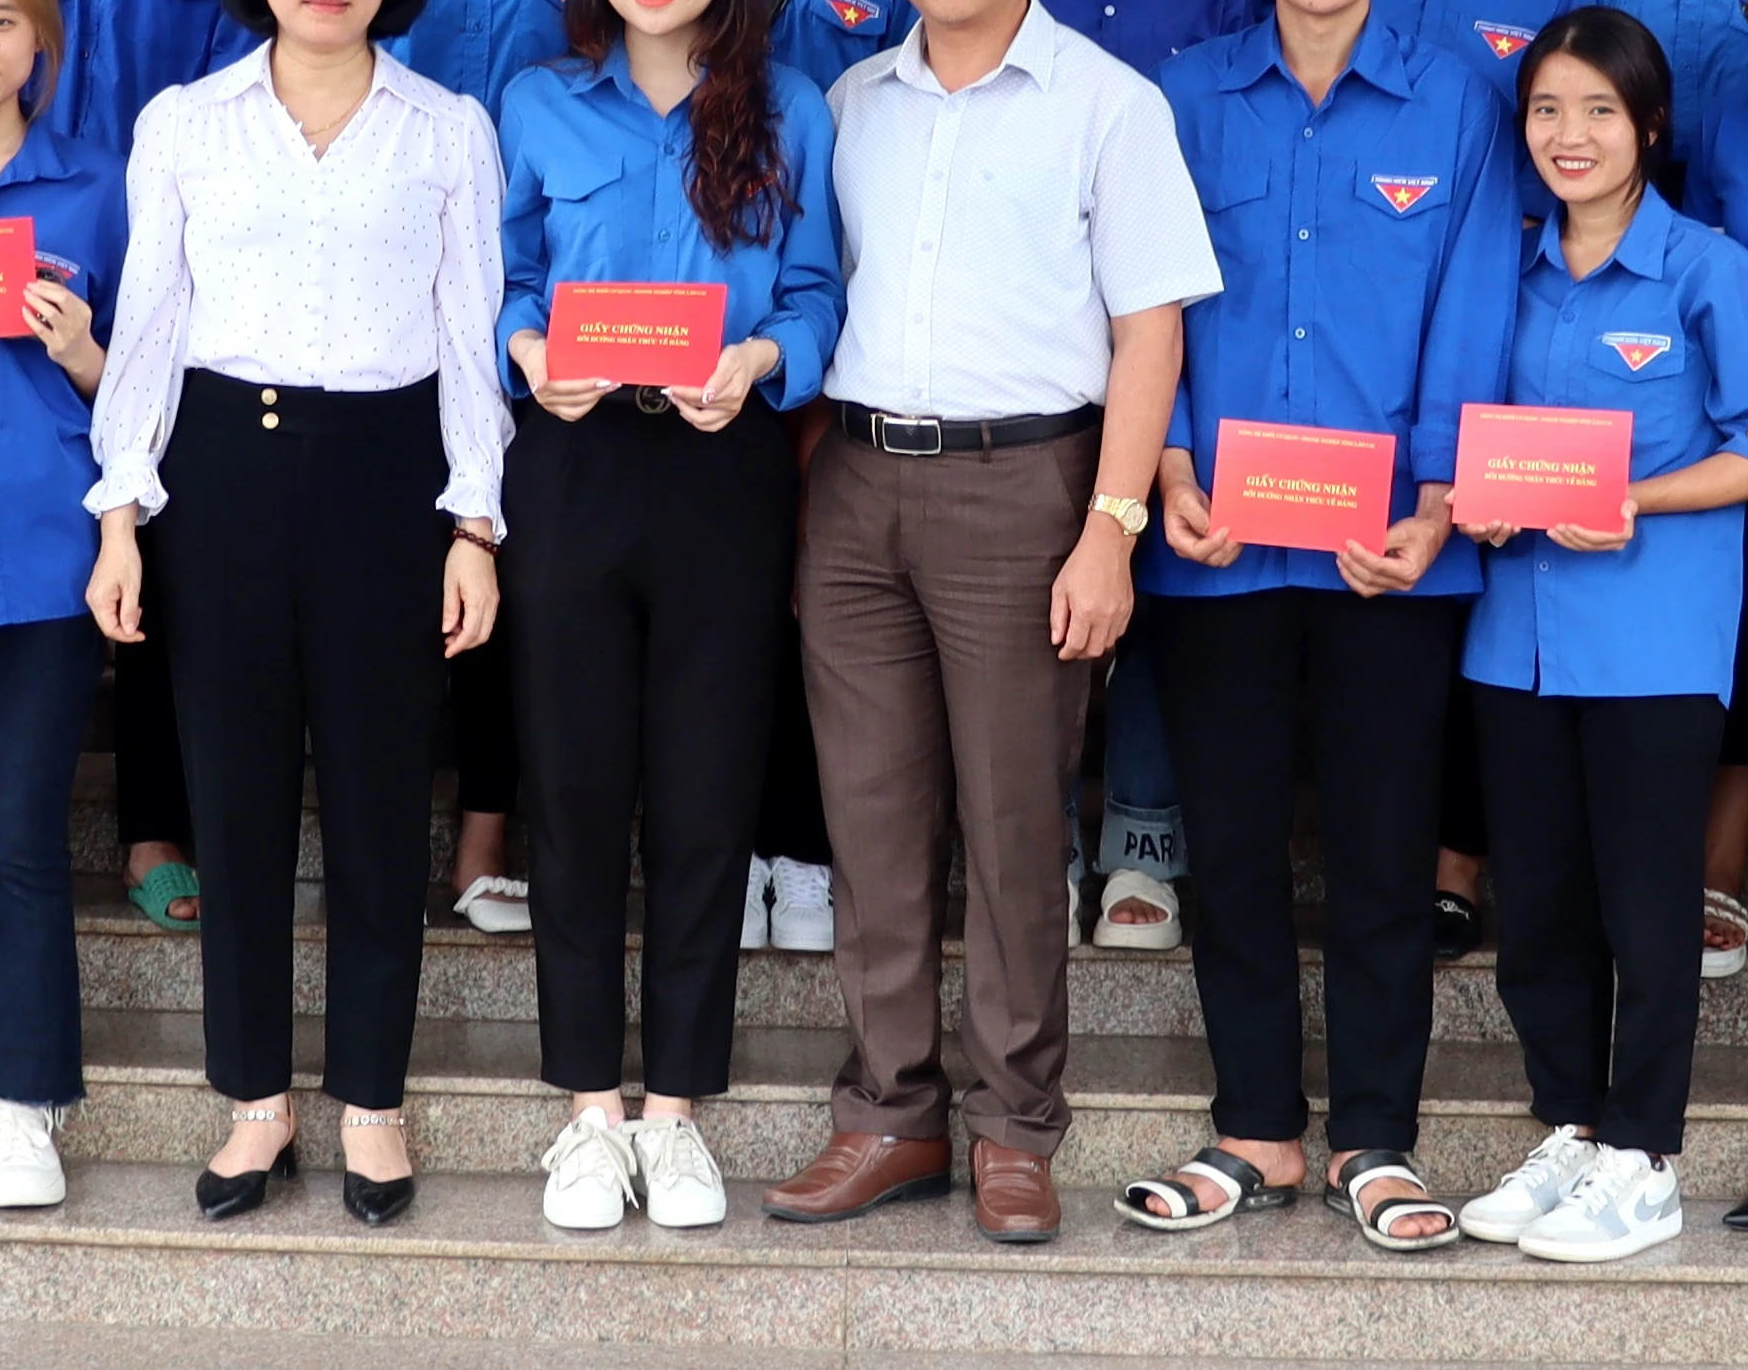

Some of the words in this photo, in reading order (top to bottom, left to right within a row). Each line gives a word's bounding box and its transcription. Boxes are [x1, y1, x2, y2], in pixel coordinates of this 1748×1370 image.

[580, 321, 609, 334] GIẤY
[612, 322, 653, 336] CHỨNG
[656, 323, 689, 337] NHẬN
[1488, 456, 1517, 470] GIẤY
[1519, 457, 1560, 473] CHỨNG
[1563, 460, 1595, 475] NHẬN
[1246, 473, 1276, 489] GIẤY
[1278, 476, 1320, 493] CHỨNG
[1323, 480, 1357, 496] NHẬN
